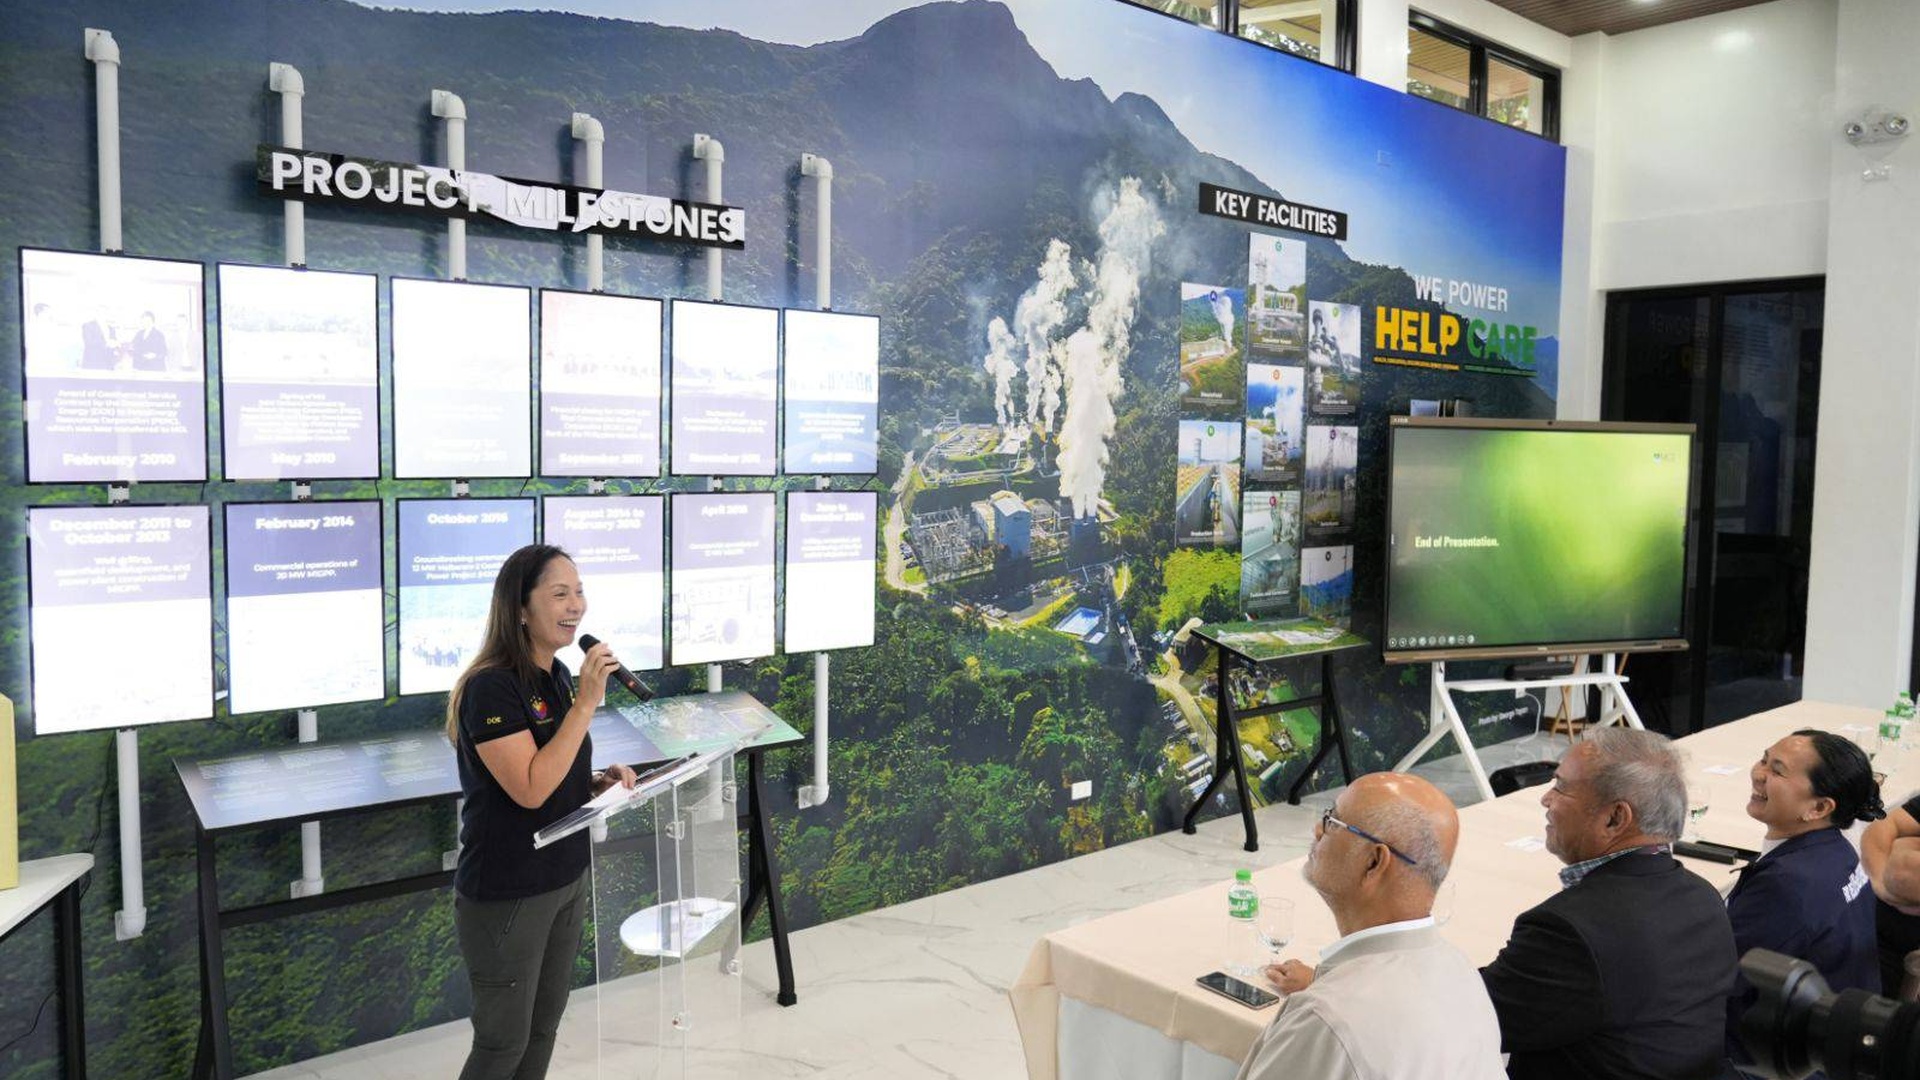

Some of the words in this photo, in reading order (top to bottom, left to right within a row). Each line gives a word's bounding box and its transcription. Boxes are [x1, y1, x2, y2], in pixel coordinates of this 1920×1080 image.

[272, 152, 486, 213] PROJECT
[506, 185, 736, 242] MILESTONES
[1215, 190, 1251, 217] KEY
[1257, 199, 1337, 235] FACILITIES
[1414, 275, 1443, 302] WE
[1449, 281, 1508, 313] POWER
[1376, 305, 1460, 356] HELP
[1467, 317, 1537, 364] CARE
[62, 453, 137, 468] February
[140, 453, 176, 465] 2010
[271, 452, 302, 466] May
[303, 452, 336, 464] 2010
[559, 453, 620, 465] September
[427, 512, 479, 524] October
[563, 508, 604, 520] August
[632, 508, 645, 518] to
[50, 518, 136, 531] December
[139, 517, 172, 529] 2011
[174, 518, 192, 528] to
[255, 517, 320, 530] February
[564, 519, 615, 531] February
[64, 532, 132, 545] October
[1414, 536, 1432, 548] End
[1433, 536, 1442, 548] of
[1444, 536, 1499, 548] Presentation.
[253, 562, 304, 573] Commercial
[306, 560, 348, 571] operations
[349, 559, 358, 567] of
[289, 571, 305, 579] MW
[486, 716, 502, 725] DOE
